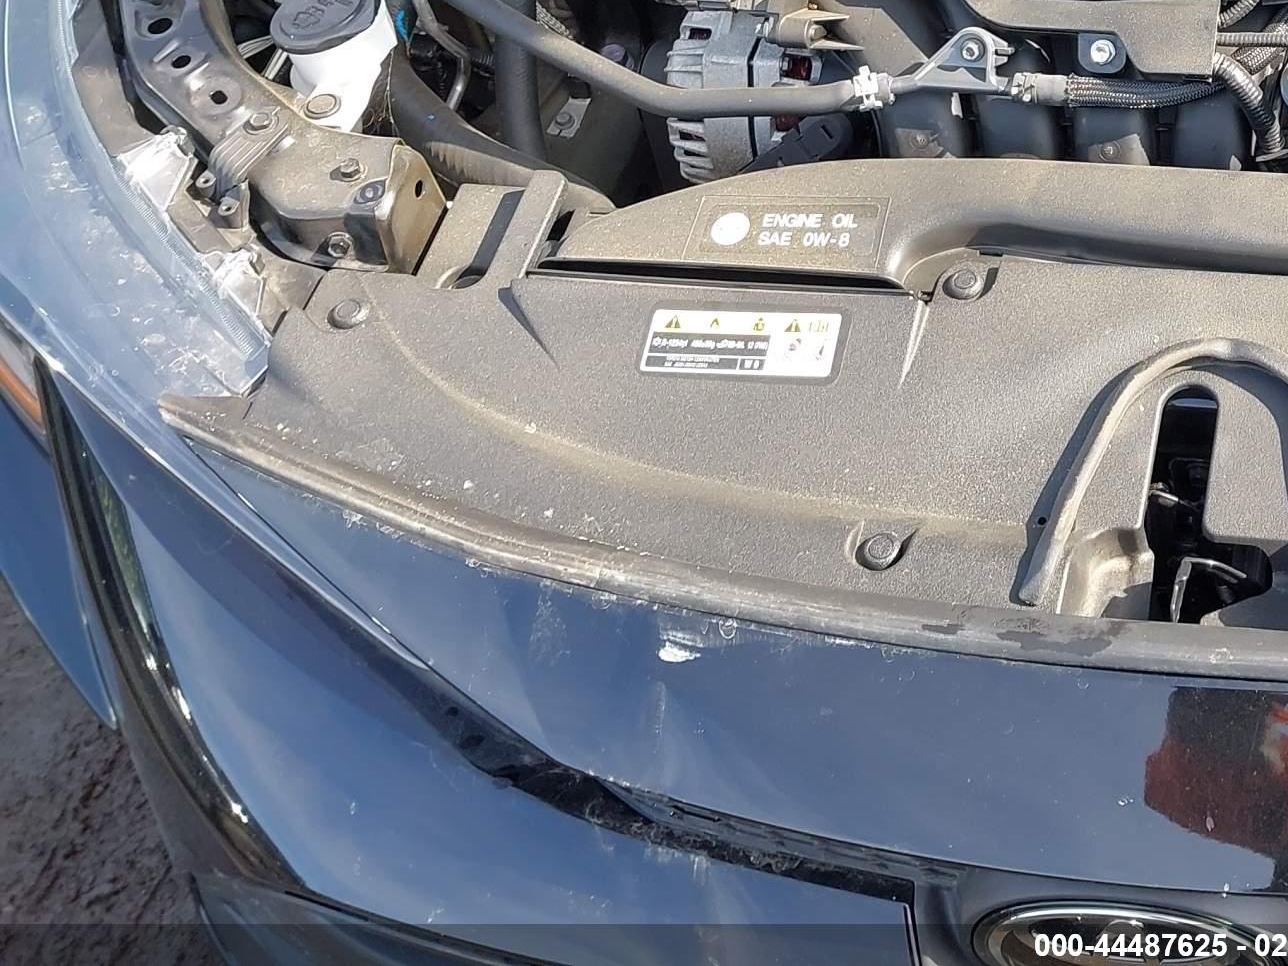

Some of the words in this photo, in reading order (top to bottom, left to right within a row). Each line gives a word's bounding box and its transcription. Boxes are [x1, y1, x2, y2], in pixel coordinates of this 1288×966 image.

[762, 213, 824, 228] ENGINE
[831, 214, 858, 228] OIL
[758, 232, 792, 246] SAE
[802, 232, 851, 247] 0W-8
